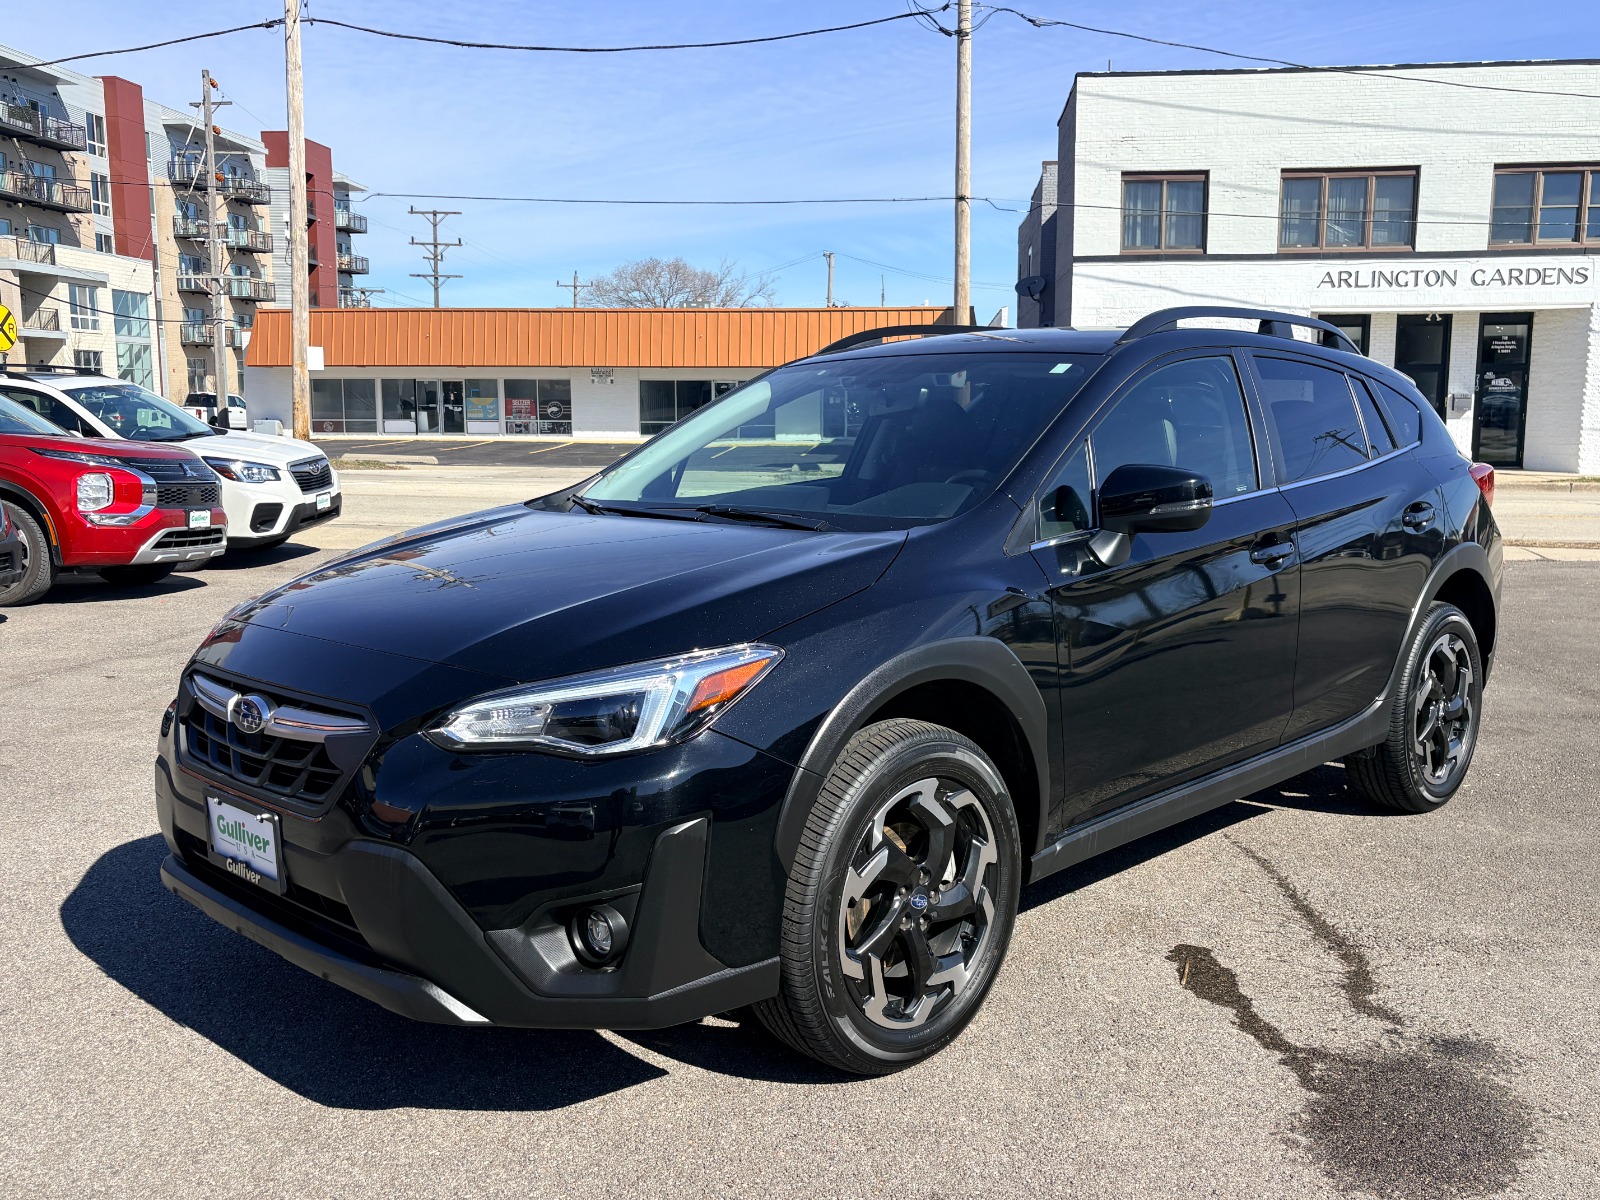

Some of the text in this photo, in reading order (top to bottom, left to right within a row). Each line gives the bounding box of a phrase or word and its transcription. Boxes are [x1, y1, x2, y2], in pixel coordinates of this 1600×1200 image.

[1316, 266, 1589, 289] ARLINGTON GARDENS
[8, 323, 15, 334] R
[216, 814, 270, 853] Gulliver
[226, 858, 261, 884] Gulliver
